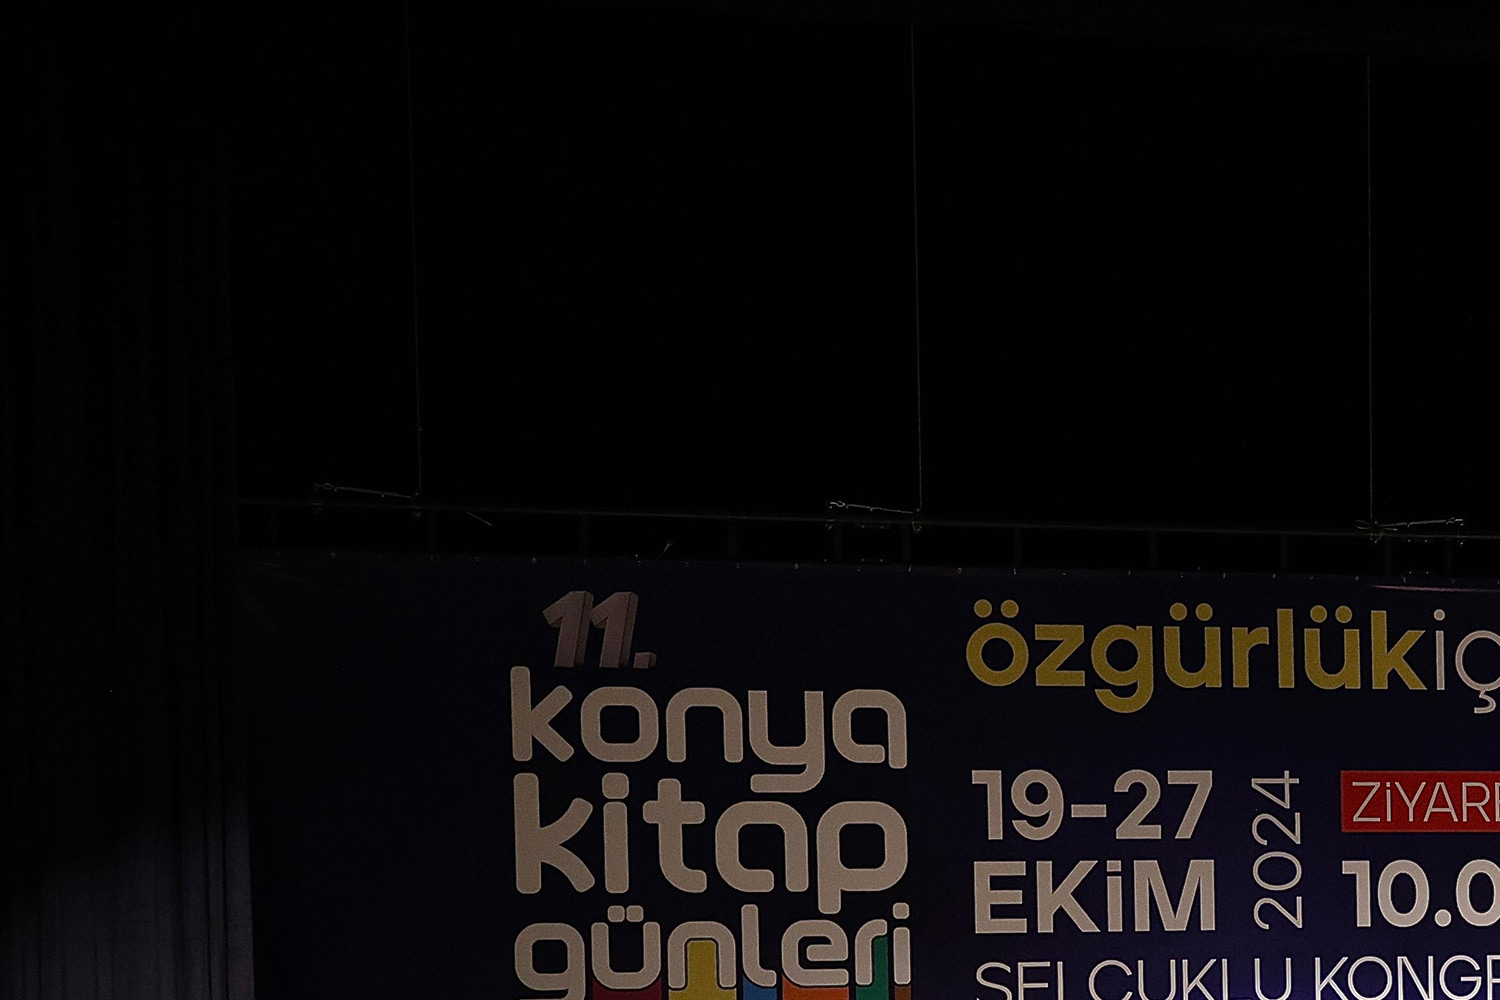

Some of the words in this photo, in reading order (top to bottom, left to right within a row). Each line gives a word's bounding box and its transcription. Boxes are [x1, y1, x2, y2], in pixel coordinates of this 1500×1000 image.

[542, 590, 657, 669] 11.
[510, 666, 908, 793] konya
[513, 772, 909, 914] kitap
[971, 769, 1213, 841] 19-27
[1251, 769, 1303, 930] 2024
